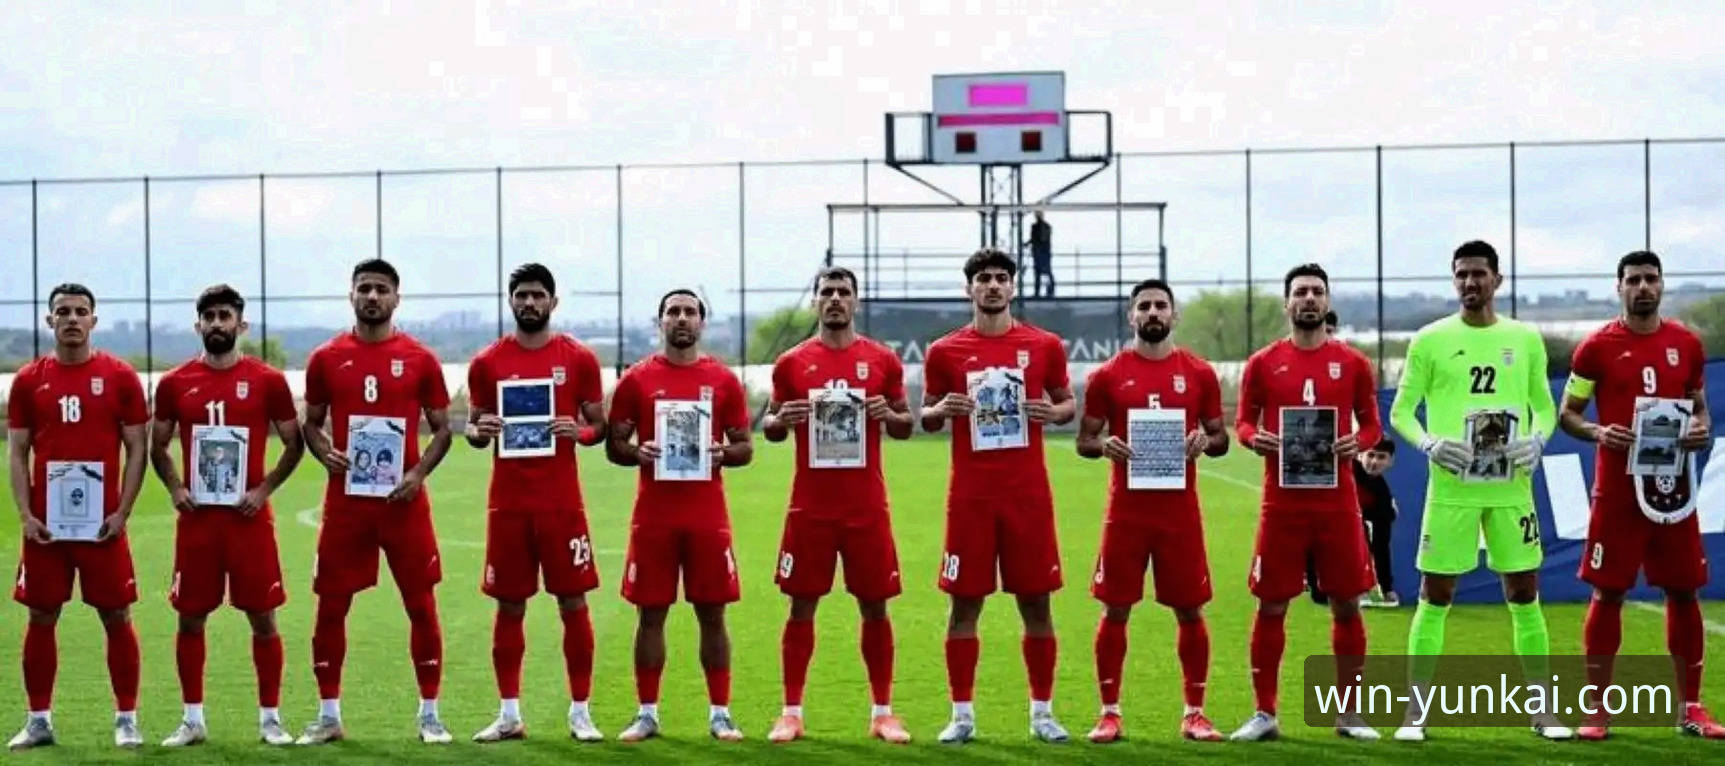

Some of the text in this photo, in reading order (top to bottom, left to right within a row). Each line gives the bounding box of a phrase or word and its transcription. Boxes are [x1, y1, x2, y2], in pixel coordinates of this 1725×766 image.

[364, 375, 379, 403] 8
[1303, 378, 1316, 406] 4
[1470, 366, 1496, 394] 22
[1642, 366, 1657, 394] 9
[58, 395, 81, 423] 18
[205, 400, 225, 426] 11
[1591, 542, 1604, 570] 9
